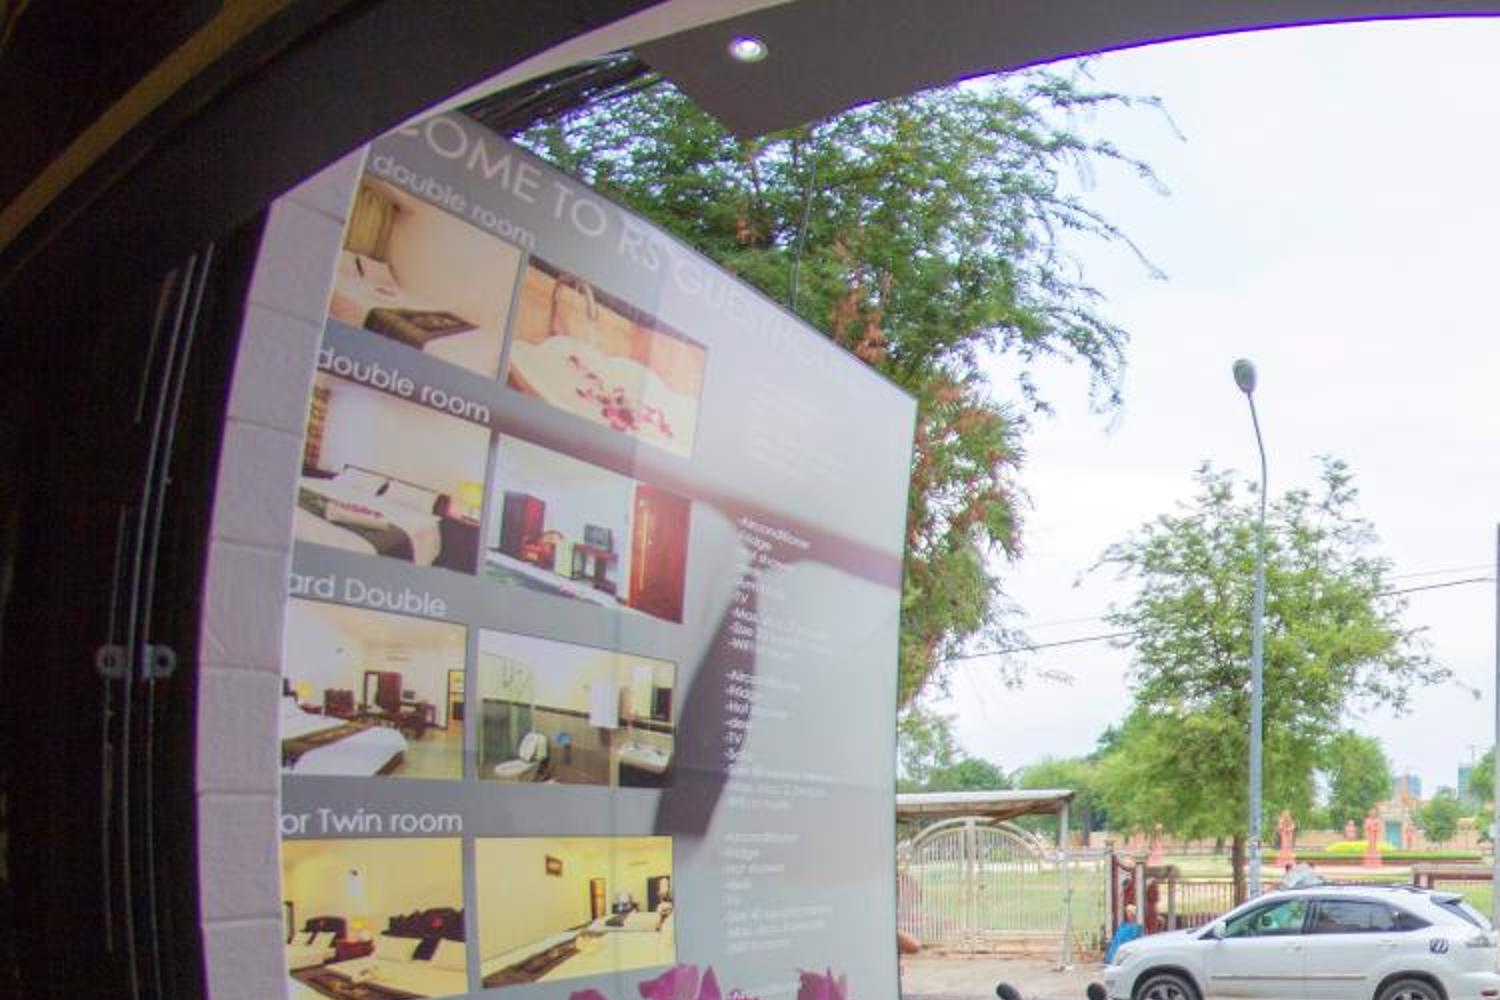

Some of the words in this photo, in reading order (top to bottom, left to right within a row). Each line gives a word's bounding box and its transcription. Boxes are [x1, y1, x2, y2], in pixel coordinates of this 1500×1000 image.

[372, 153, 467, 210] double
[471, 203, 537, 250] room
[551, 178, 608, 238] TO
[317, 346, 415, 397] double
[420, 384, 491, 423] room
[344, 577, 448, 618] Double
[279, 813, 311, 834] or
[316, 807, 383, 834] Twin
[390, 813, 464, 834] room
